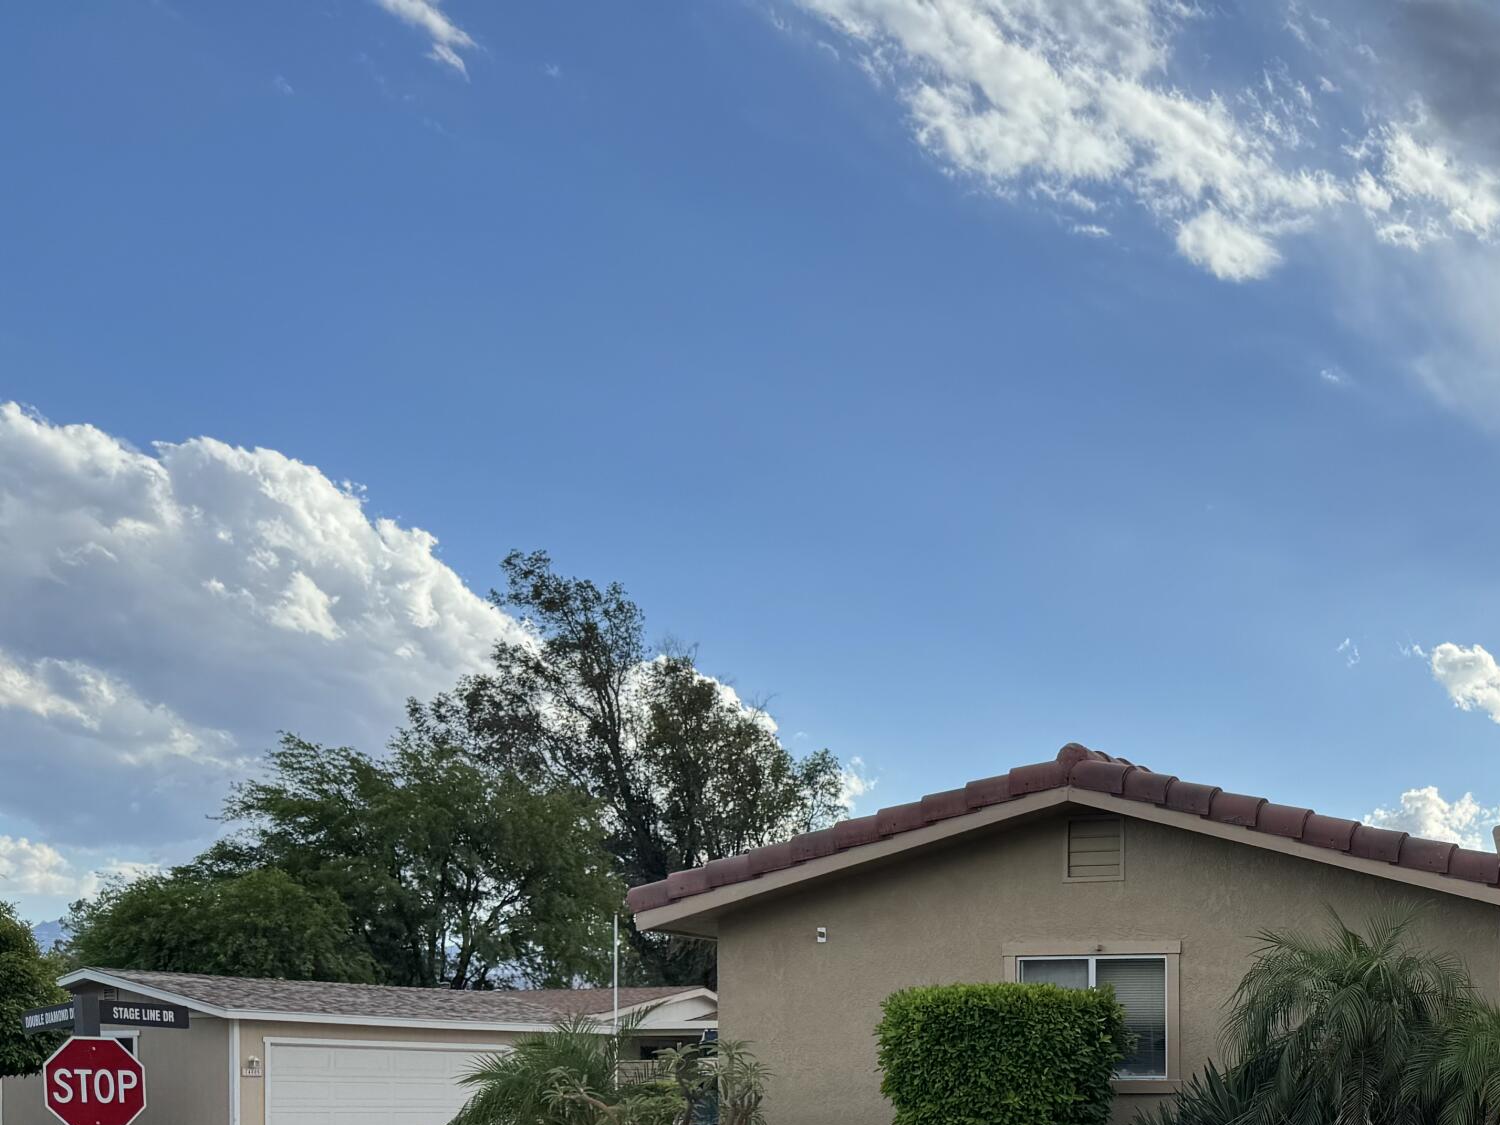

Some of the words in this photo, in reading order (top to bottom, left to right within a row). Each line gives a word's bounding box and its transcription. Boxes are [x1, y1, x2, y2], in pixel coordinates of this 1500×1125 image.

[25, 1013, 45, 1028] DOUBLE
[45, 1008, 69, 1024] DIAMOND
[113, 1006, 141, 1020] STAGE
[142, 1008, 161, 1022] LINE
[162, 1010, 175, 1023] DR
[53, 1068, 138, 1104] STOP
